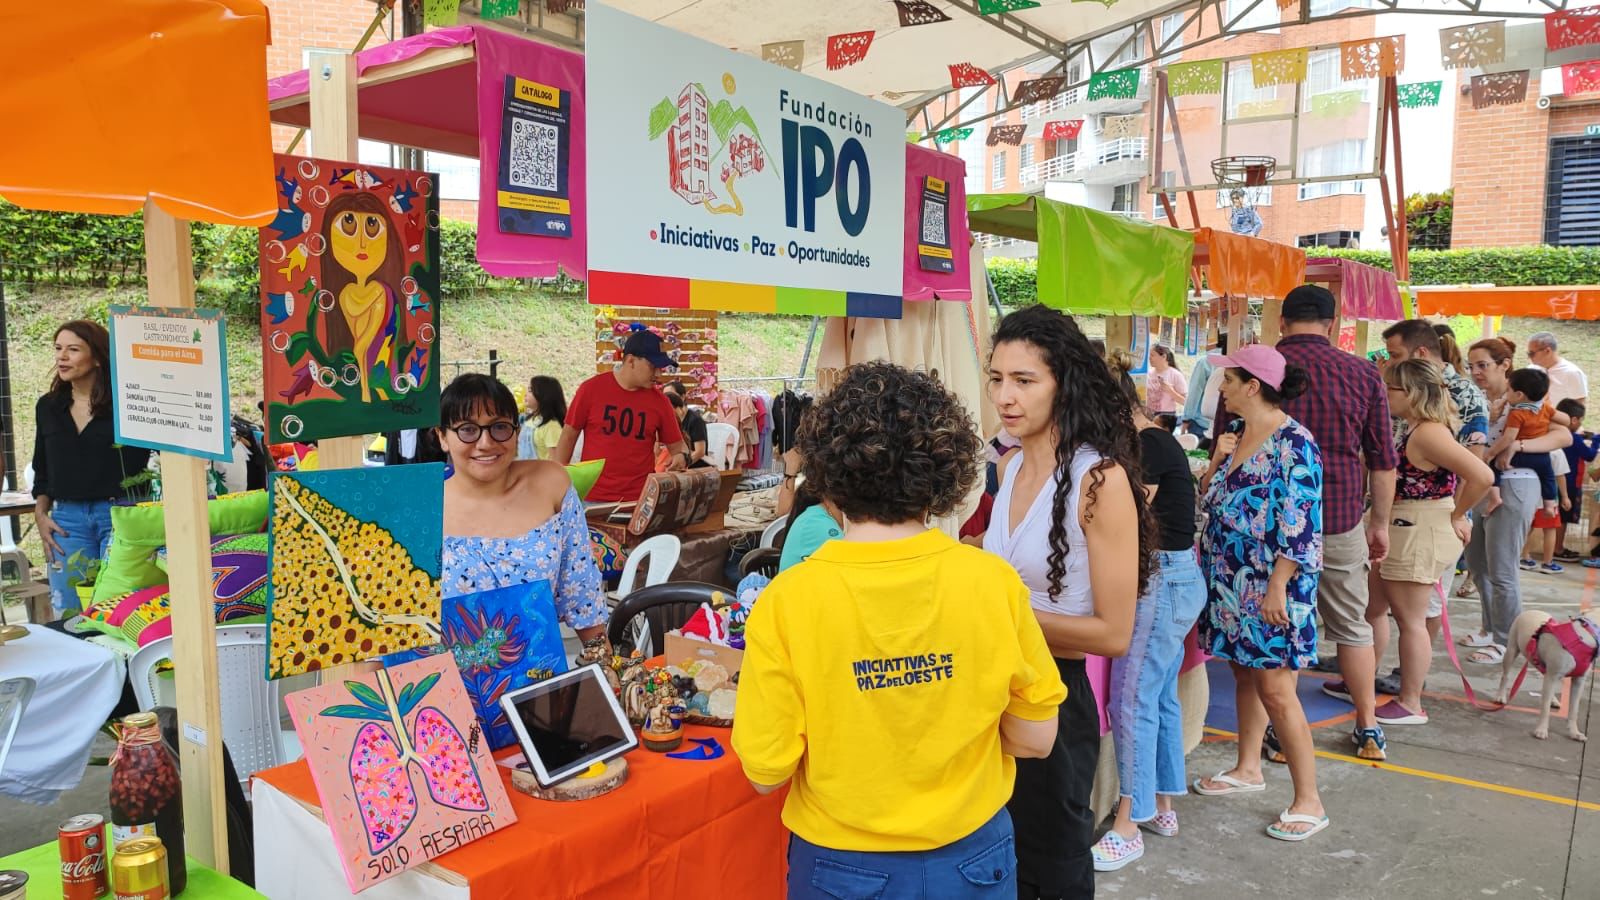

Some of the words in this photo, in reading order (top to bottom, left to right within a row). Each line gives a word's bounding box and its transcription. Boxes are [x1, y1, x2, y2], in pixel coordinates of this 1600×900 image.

[521, 85, 552, 101] CATALOGO
[779, 89, 872, 138] Fundación
[780, 118, 871, 237] IPO
[660, 223, 739, 252] Iniciativas
[751, 239, 776, 256] Paz
[787, 241, 871, 268] Oportunidades
[162, 323, 188, 333] EVENTOS
[602, 404, 647, 441] 501
[852, 653, 937, 677] INICIATIVAS
[940, 653, 953, 664] DE
[856, 674, 887, 692] PAZ
[886, 676, 905, 688] DEL
[903, 665, 953, 686] OESTE
[368, 845, 410, 880] SOLO
